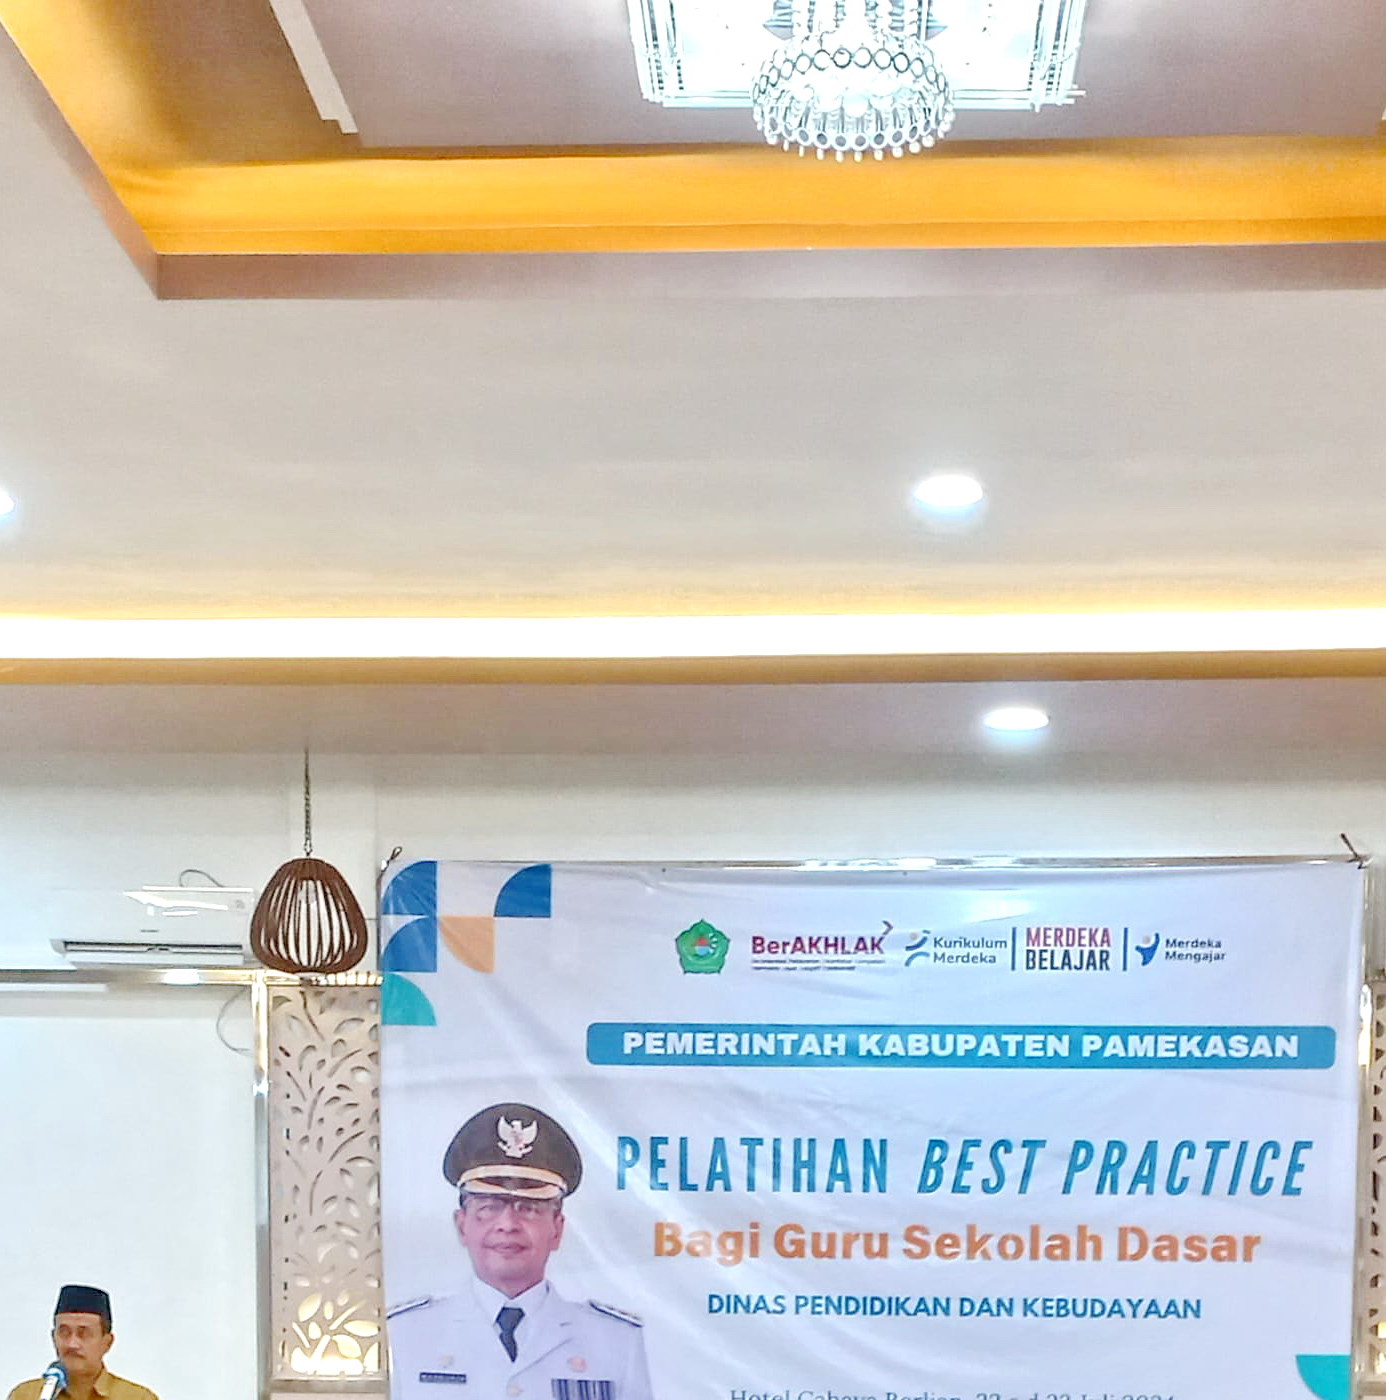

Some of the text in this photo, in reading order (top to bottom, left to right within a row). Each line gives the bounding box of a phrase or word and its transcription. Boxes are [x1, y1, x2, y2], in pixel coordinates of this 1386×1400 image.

[750, 935, 886, 956] BerAKHLAK
[933, 936, 1008, 950] Kurikulum
[1025, 926, 1112, 948] MERDEKA
[1165, 937, 1222, 950] Merdeka
[933, 951, 997, 965] Merdeka
[1025, 949, 1111, 971] BELAJAR
[1164, 950, 1227, 963] Mengajar
[622, 1031, 1299, 1059] PEMERINTAH KABUPATEN PAMEKASAN
[616, 1135, 1314, 1197] PELATIHAN BEST PRACTICE
[653, 1221, 1262, 1267] Bagi Guru Sekolah Dasar
[707, 1293, 1202, 1320] DINAS PENDIDIKAN DAN KEBUDAYAAN
